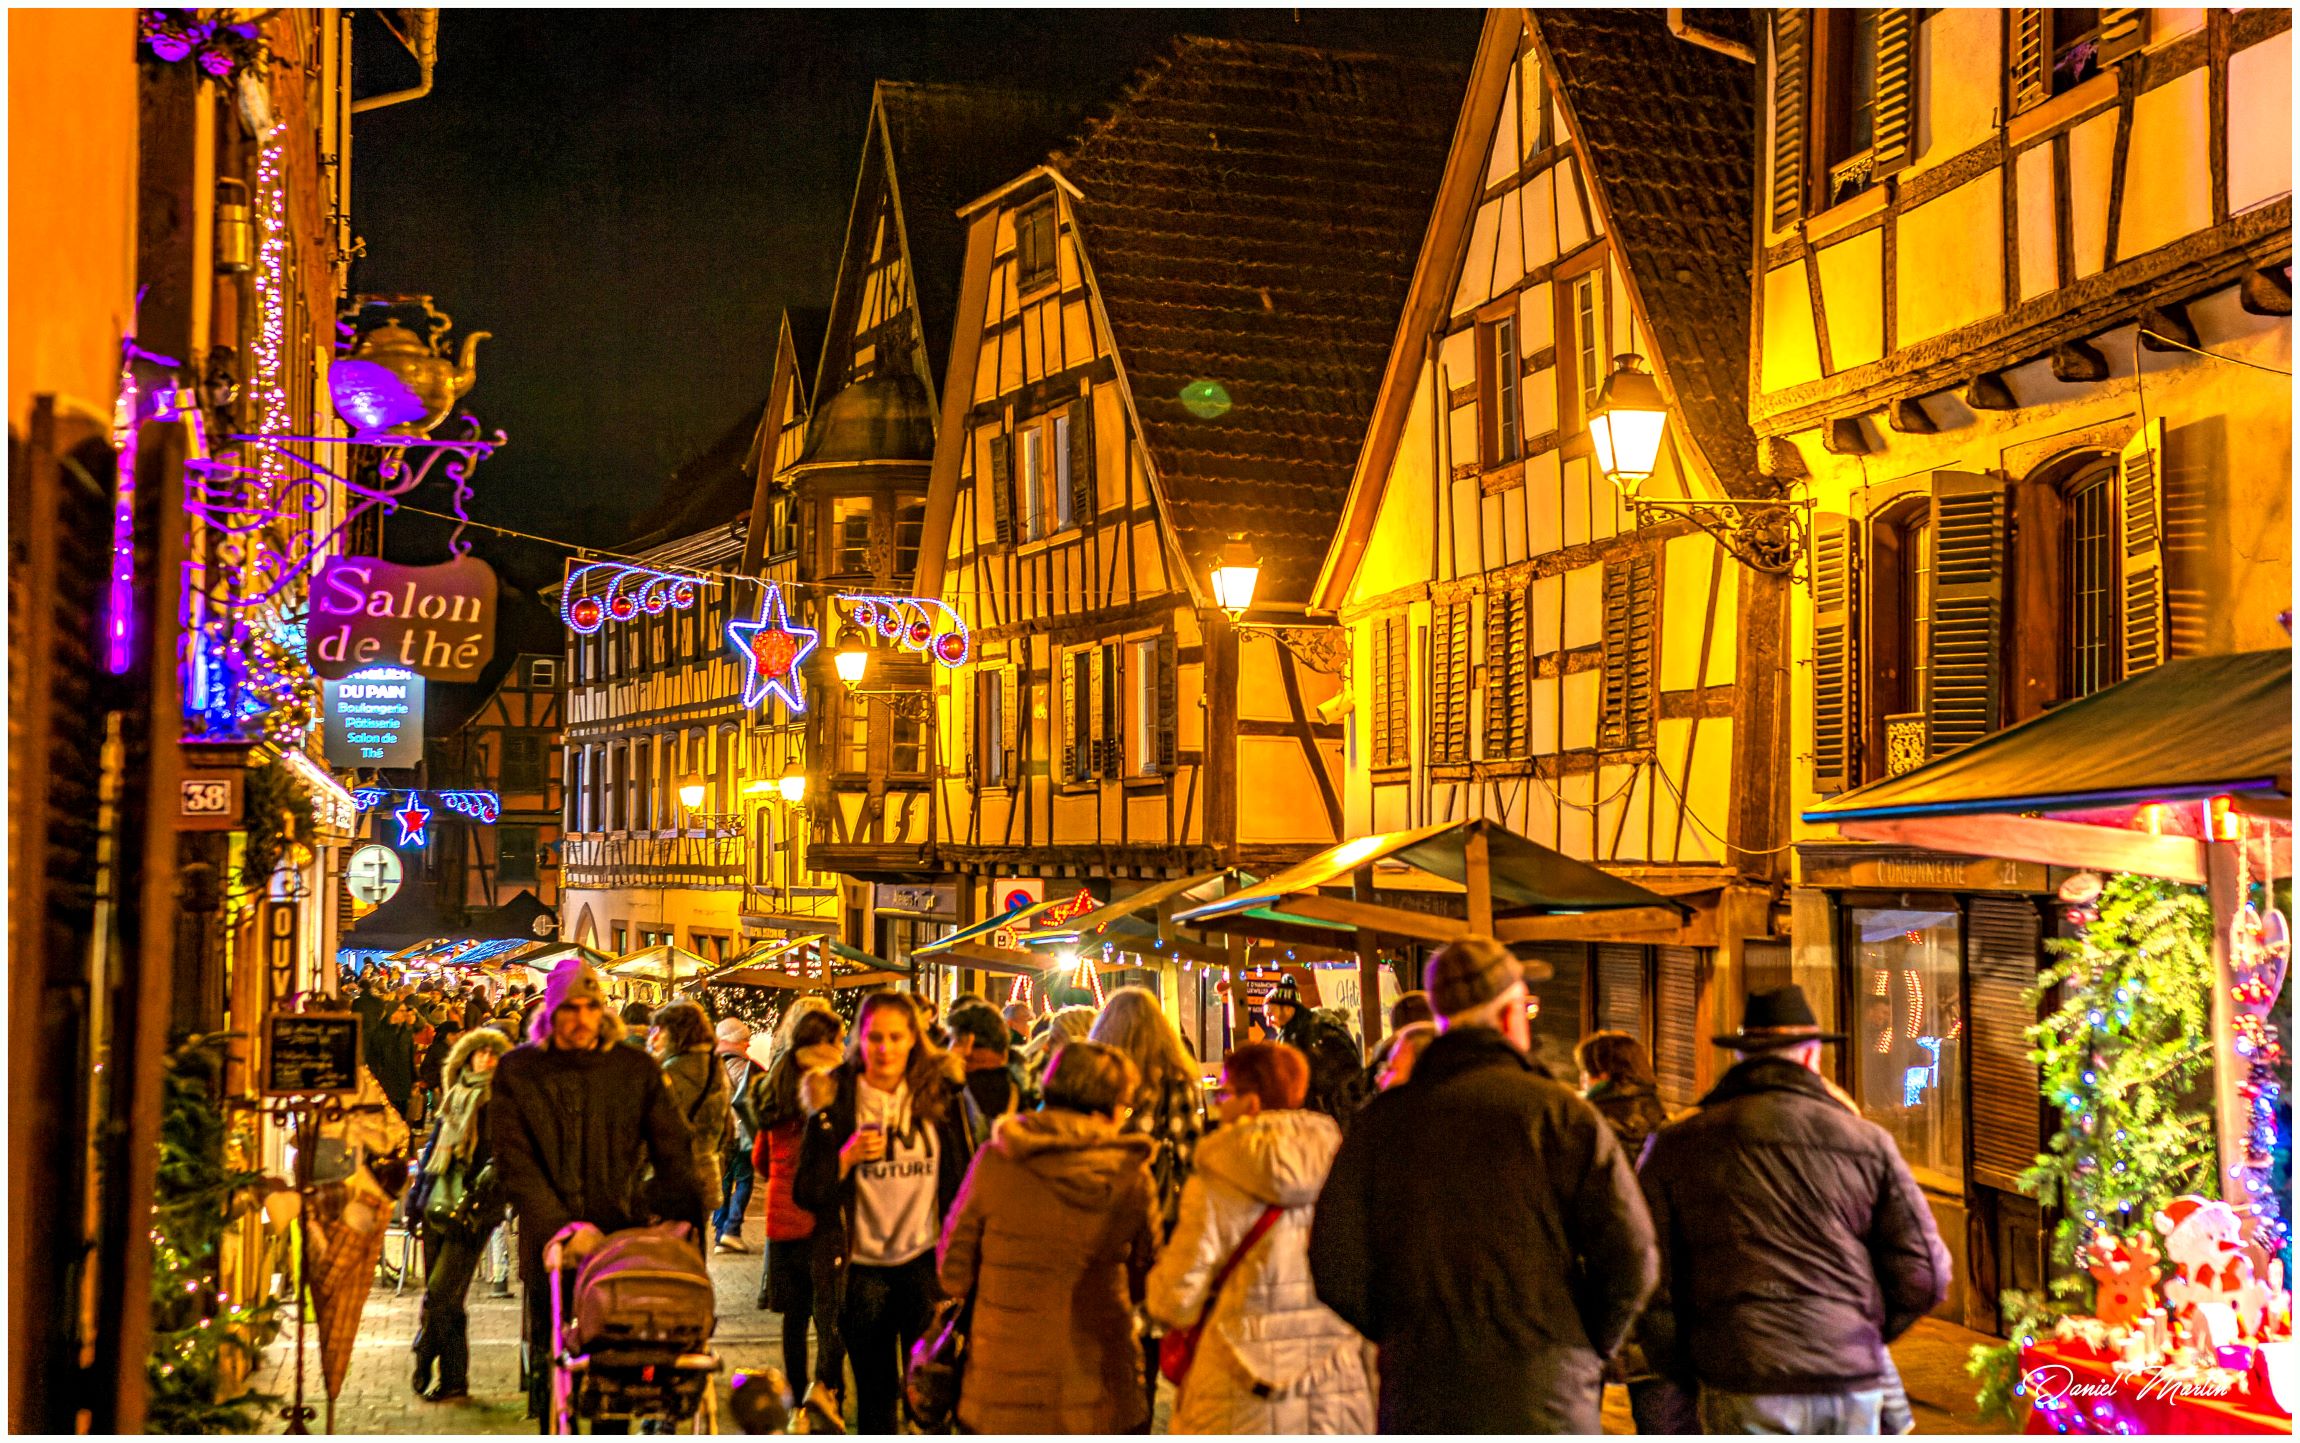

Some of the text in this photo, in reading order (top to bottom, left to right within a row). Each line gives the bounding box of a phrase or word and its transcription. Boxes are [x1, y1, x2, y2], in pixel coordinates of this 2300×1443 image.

[320, 566, 482, 623] Salon
[318, 625, 483, 669] de thé
[339, 685, 406, 698] DU PAIN
[337, 702, 408, 715] Boulangerie
[345, 716, 400, 728] Pâtisserie
[347, 732, 397, 743] Salon de
[360, 747, 384, 758] Thé
[186, 784, 225, 811] 38
[862, 1160, 934, 1179] FUTURE
